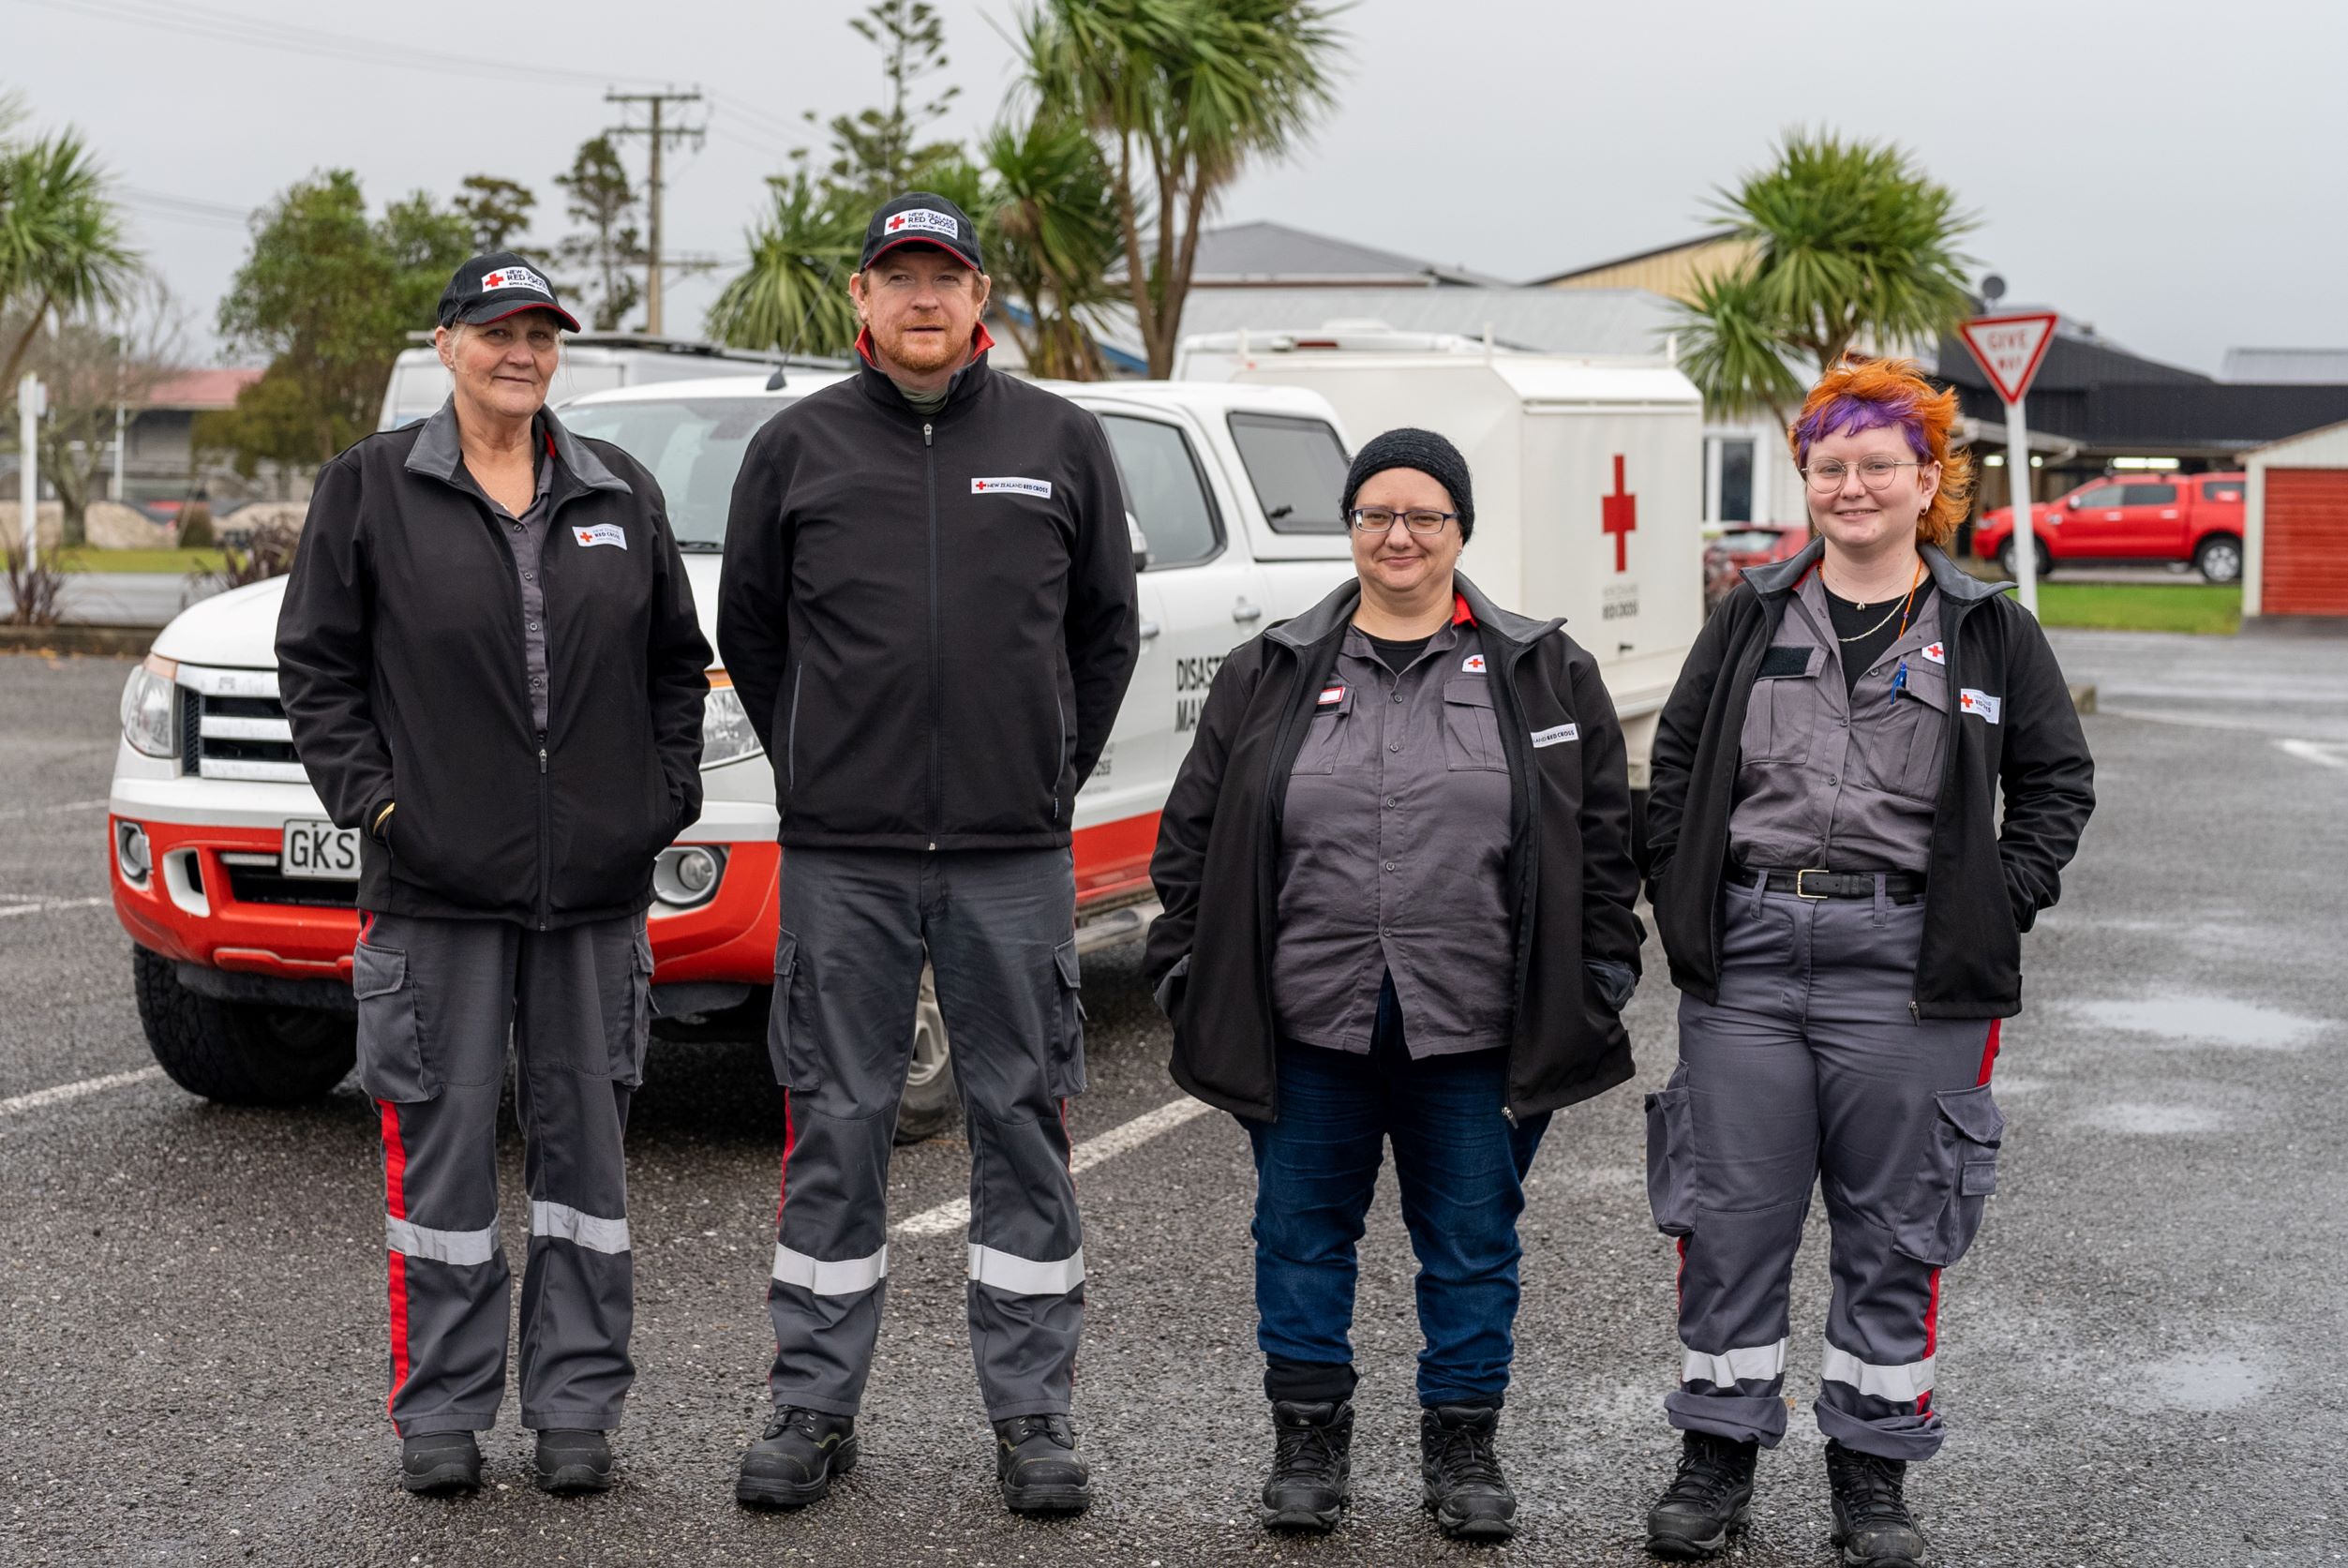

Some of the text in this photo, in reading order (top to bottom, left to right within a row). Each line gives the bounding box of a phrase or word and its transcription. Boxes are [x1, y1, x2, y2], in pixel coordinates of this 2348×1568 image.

[929, 217, 955, 231] CROSS
[1989, 331, 2026, 350] GIVE
[1033, 485, 1048, 493] CROSS
[1176, 656, 1225, 691] DISAST
[292, 829, 355, 870] GKS
